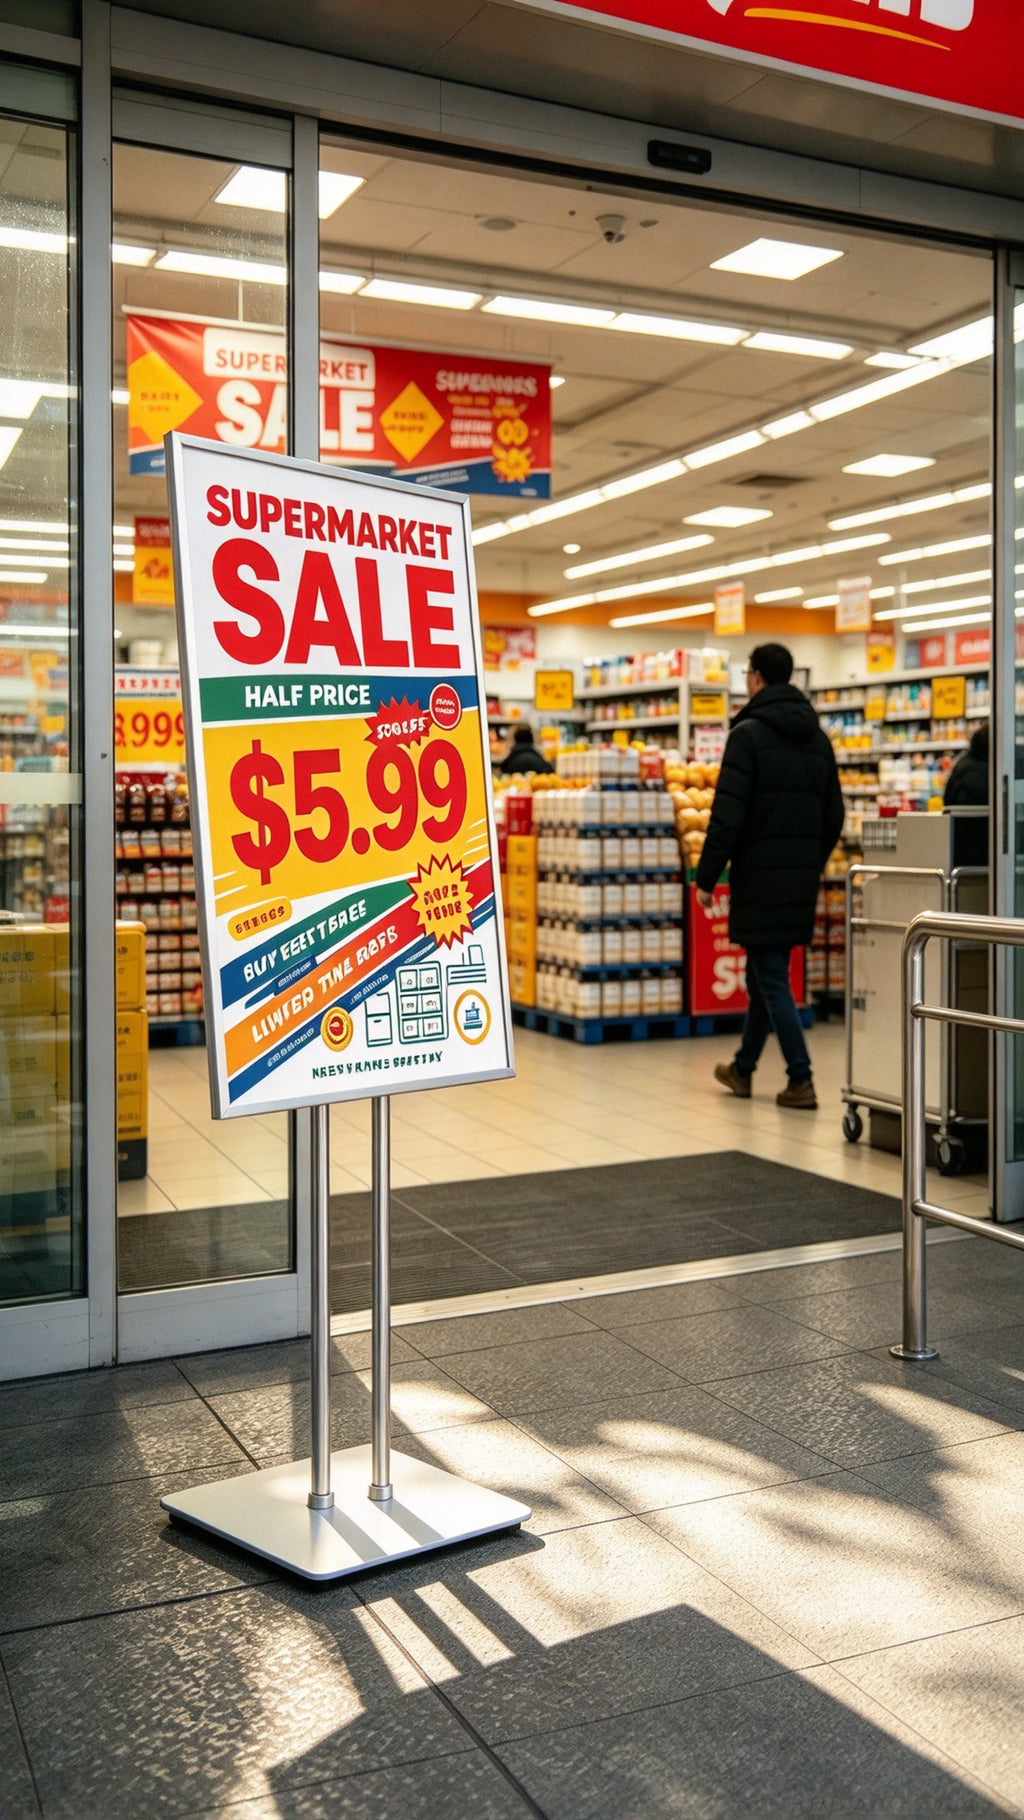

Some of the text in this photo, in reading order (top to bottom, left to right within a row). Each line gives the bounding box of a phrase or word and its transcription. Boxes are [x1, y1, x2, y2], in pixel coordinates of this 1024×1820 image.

[216, 348, 369, 382] SUPERRKET
[206, 485, 452, 560] SUPERMARKET
[212, 537, 461, 670] SALE
[244, 684, 371, 708] HALF PRICE
[229, 738, 468, 886] $5.99
